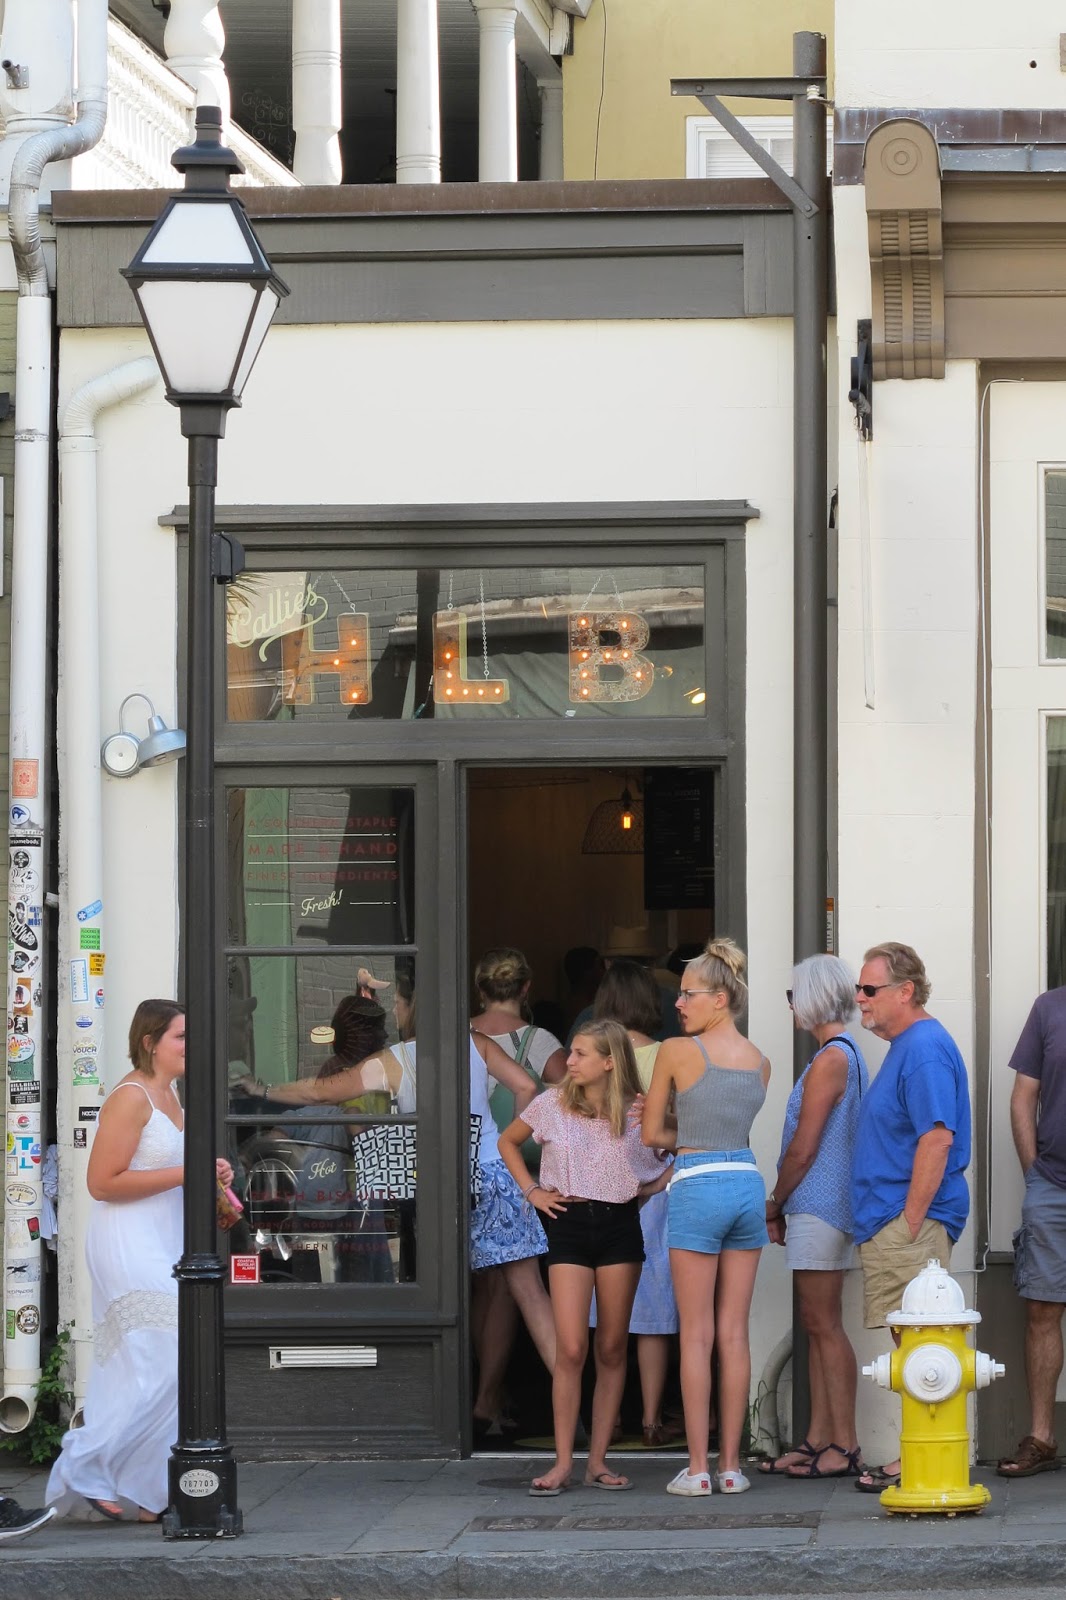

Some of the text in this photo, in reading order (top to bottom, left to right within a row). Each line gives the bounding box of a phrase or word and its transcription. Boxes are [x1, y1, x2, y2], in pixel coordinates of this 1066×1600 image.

[249, 819, 256, 828] A
[348, 816, 397, 828] STAPLE
[248, 843, 305, 855] MADE
[339, 842, 397, 855] HAND
[247, 871, 398, 881] FINEST INGREDIENTS
[301, 889, 344, 917] Fresh!
[308, 1158, 337, 1180] Hot
